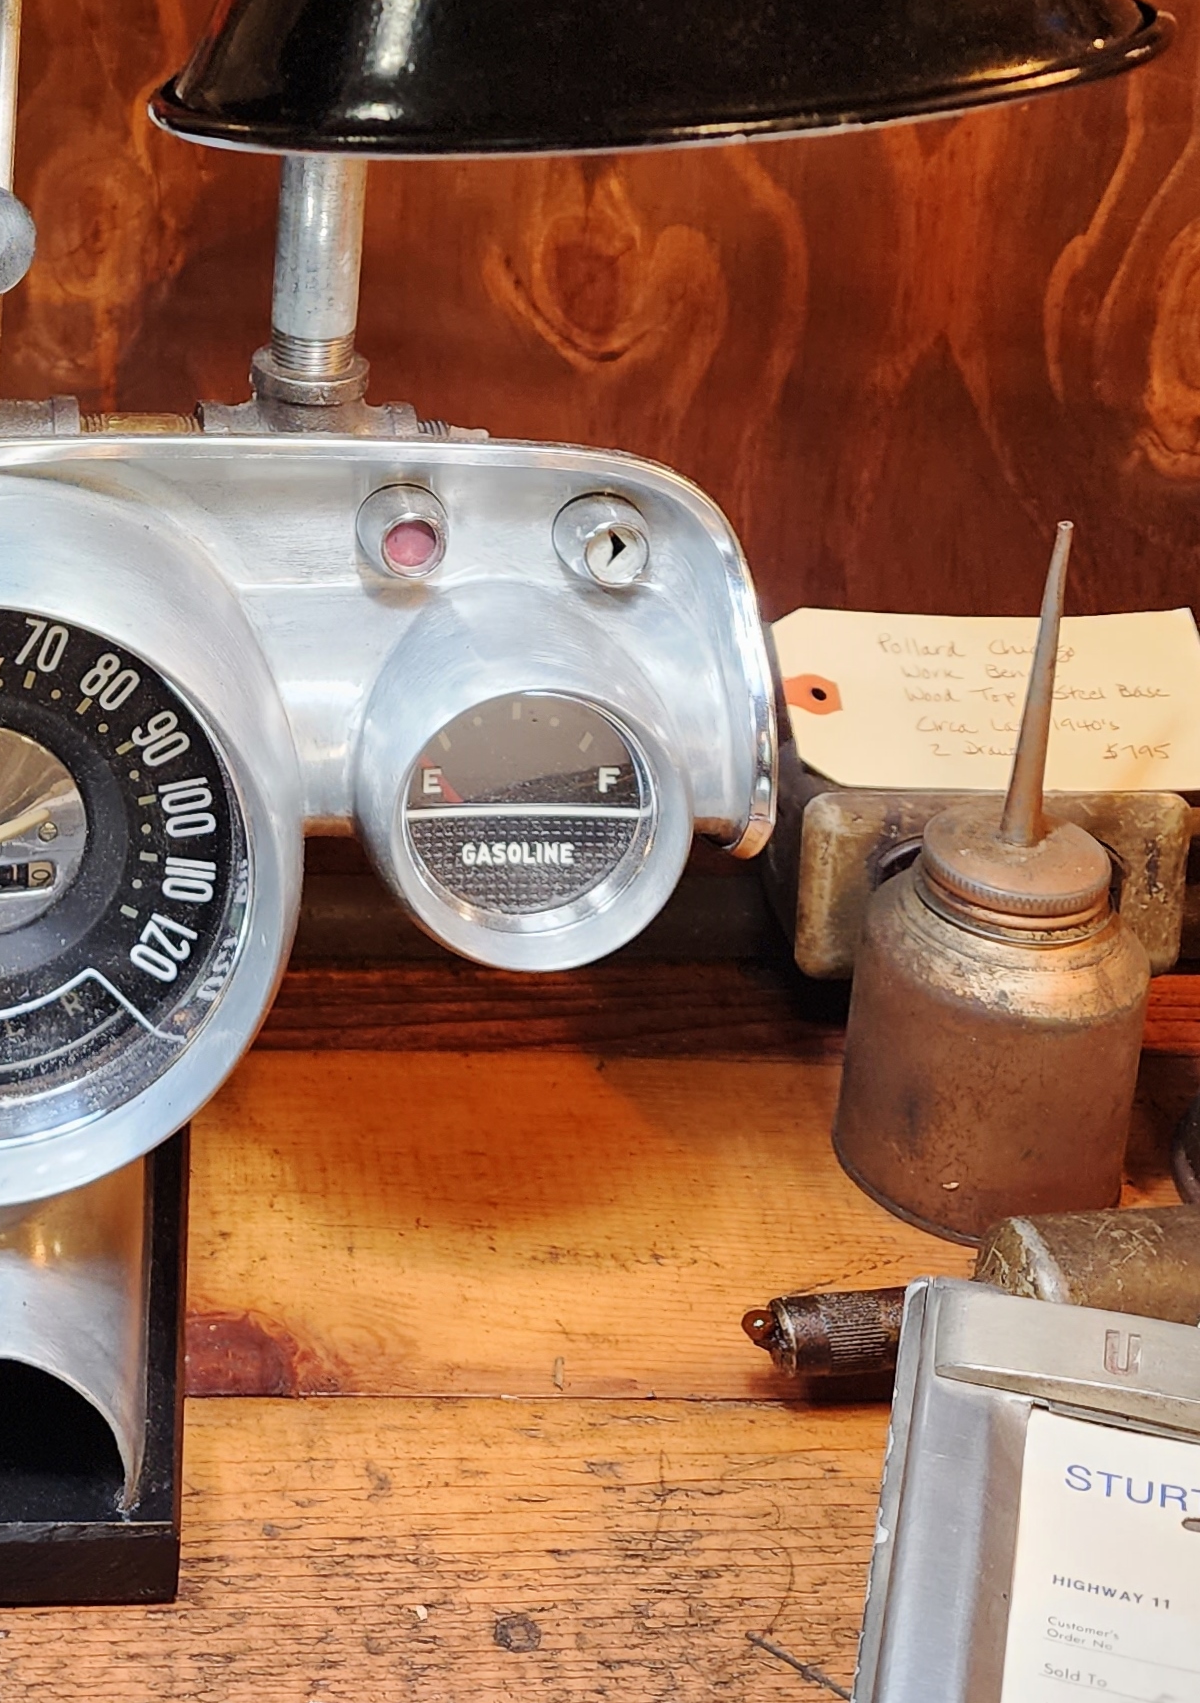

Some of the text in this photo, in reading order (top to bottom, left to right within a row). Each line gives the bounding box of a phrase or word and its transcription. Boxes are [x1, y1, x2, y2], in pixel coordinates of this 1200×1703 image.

[15, 618, 69, 673] 70
[878, 633, 1075, 663] Pollard Chicgo
[79, 653, 140, 711] 80
[903, 687, 961, 703] Wood
[1115, 683, 1171, 699] Base
[131, 710, 190, 767] 90
[1052, 716, 1121, 732] 1940's
[930, 743, 951, 757] 2
[421, 766, 621, 794] E F
[157, 776, 217, 838] 100
[461, 841, 576, 866] GASOLINE
[162, 856, 217, 903] 110
[130, 912, 198, 982] 120
[1051, 1573, 1171, 1610] HIGHWAY 11
[1046, 1615, 1120, 1640] Customer's
[1046, 1627, 1087, 1645] Order
[1042, 1661, 1108, 1689] Sold To
